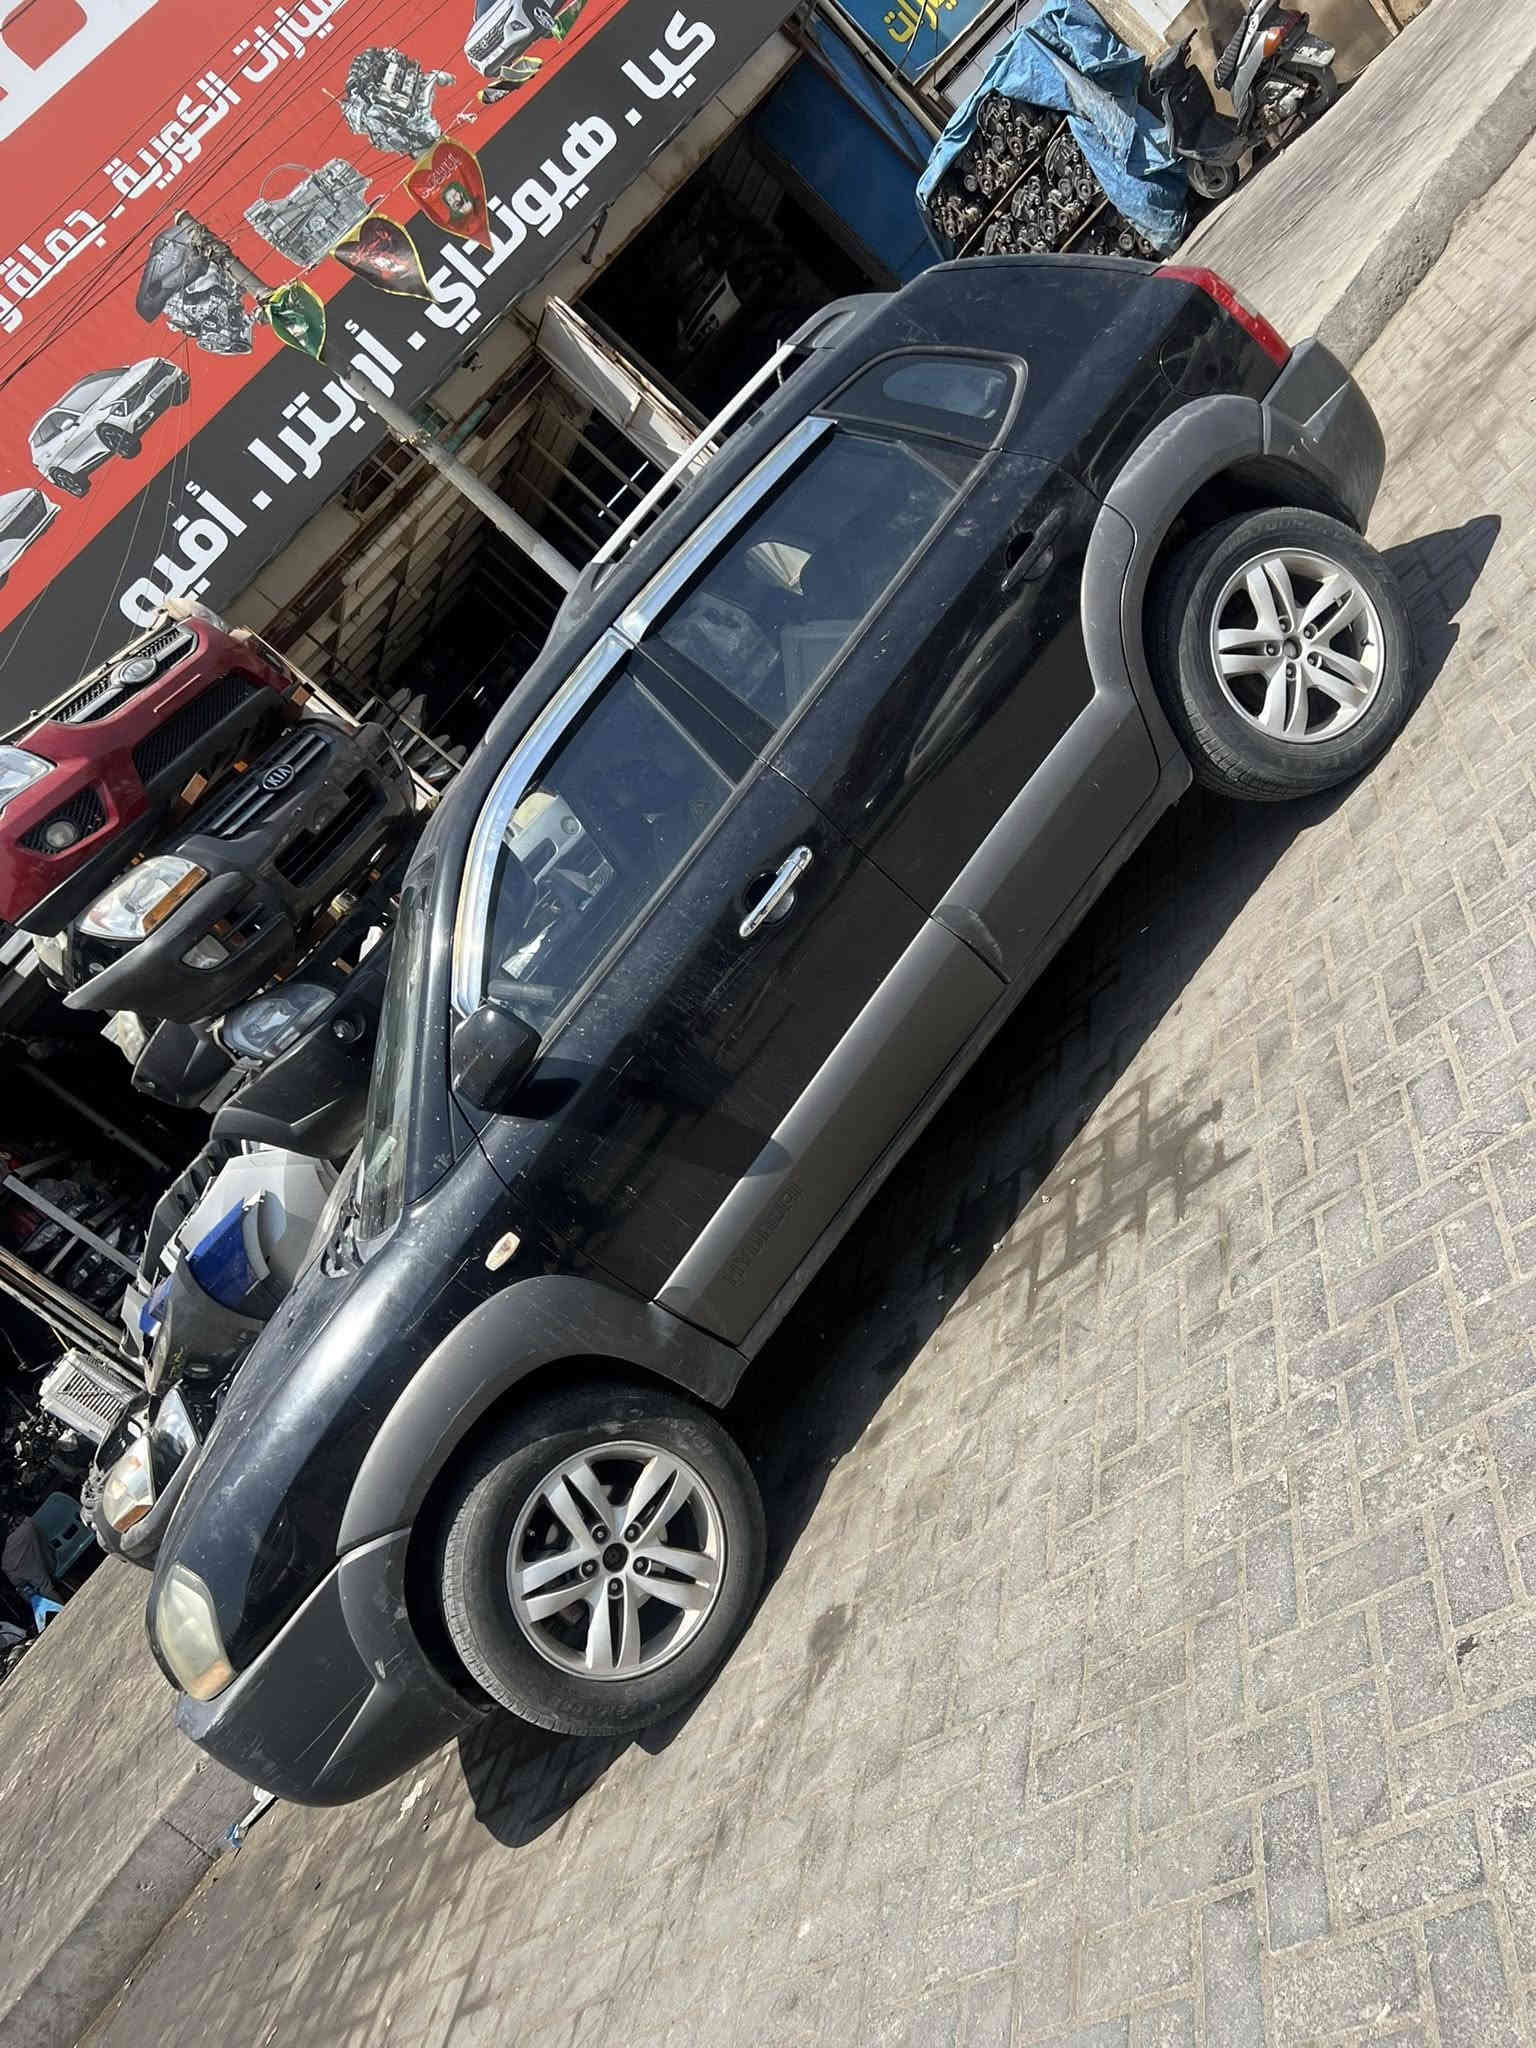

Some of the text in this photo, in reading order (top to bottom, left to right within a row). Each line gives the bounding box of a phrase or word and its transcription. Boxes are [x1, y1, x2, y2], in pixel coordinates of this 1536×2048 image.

[621, 9, 716, 100] كيا
[103, 70, 241, 199] الكورية
[0, 209, 107, 299] جملة
[424, 116, 617, 335] هيونداي
[120, 480, 247, 629] أفيو
[265, 766, 292, 787] KIA
